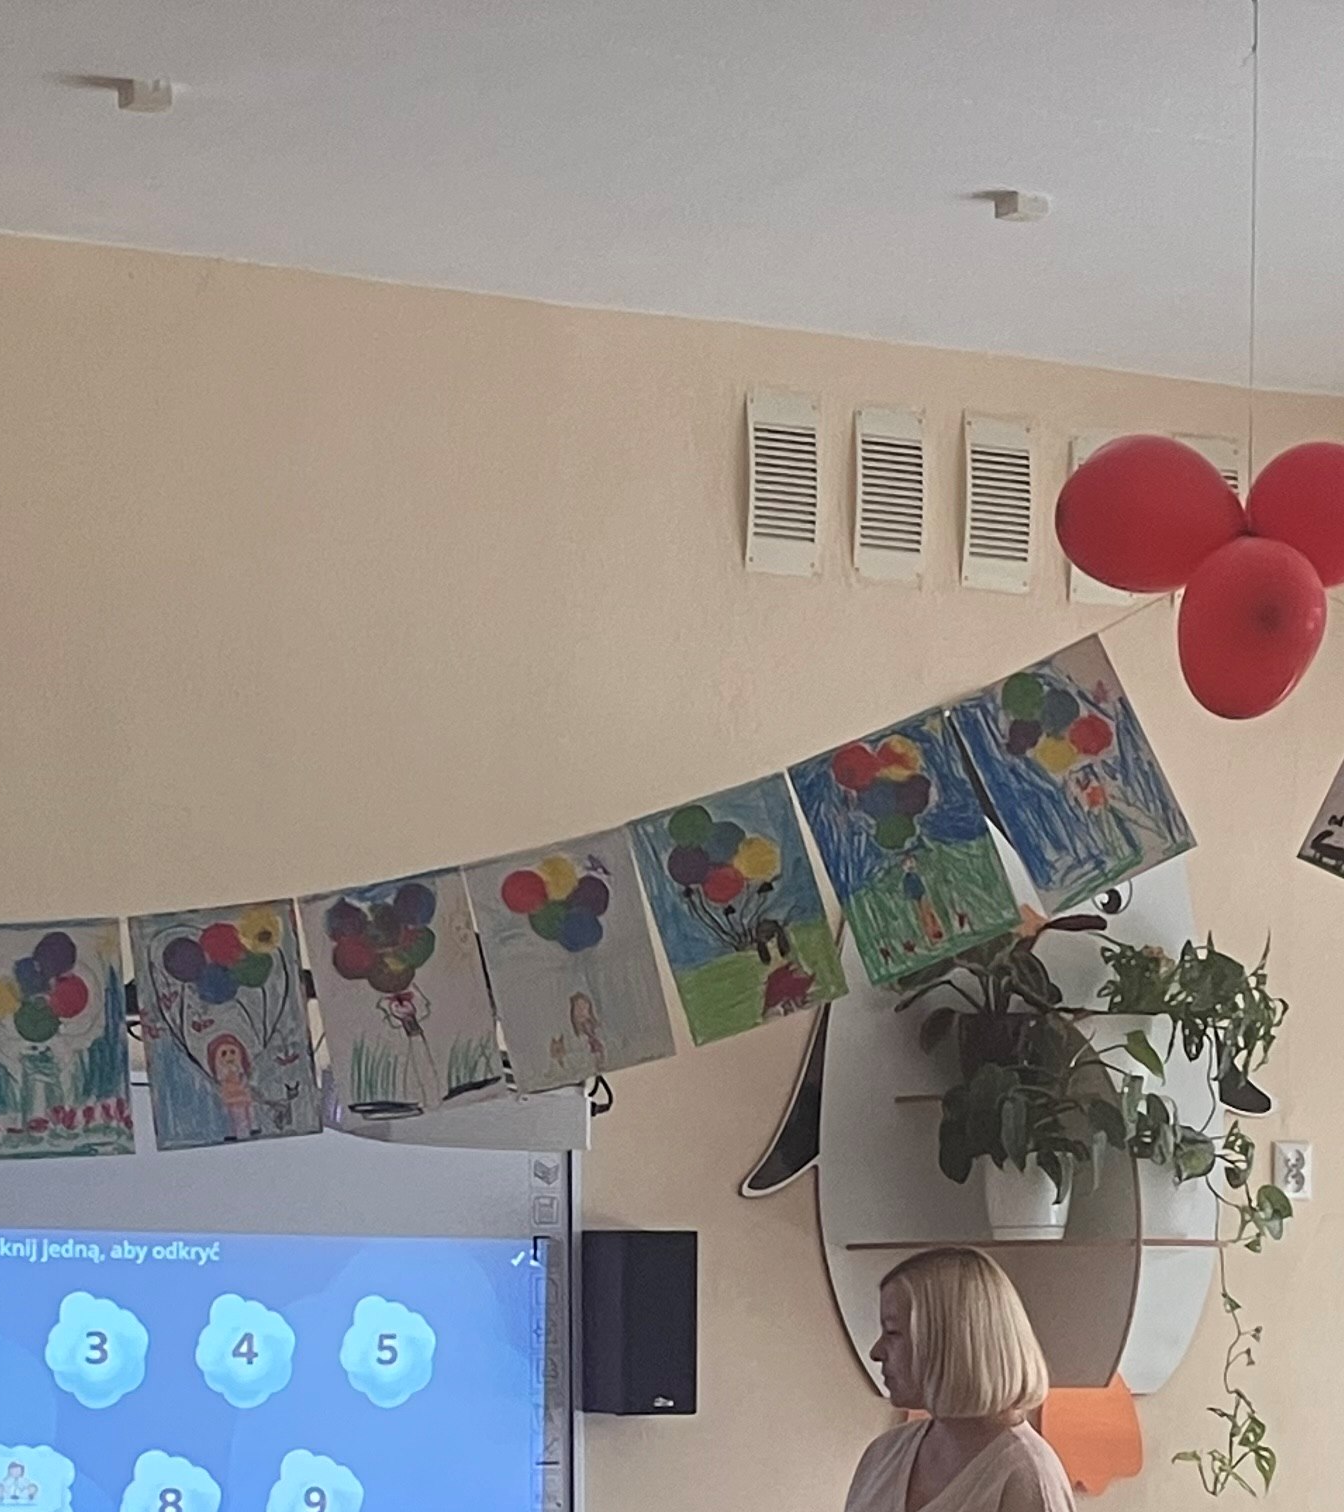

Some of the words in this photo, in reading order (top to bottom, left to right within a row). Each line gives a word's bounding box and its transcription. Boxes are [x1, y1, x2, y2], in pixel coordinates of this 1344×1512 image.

[40, 1238, 106, 1263] jedną,
[109, 1239, 147, 1265] aby
[151, 1240, 221, 1266] odkryć
[85, 1330, 108, 1365] 3
[231, 1332, 259, 1365] 4
[376, 1333, 398, 1366] 5
